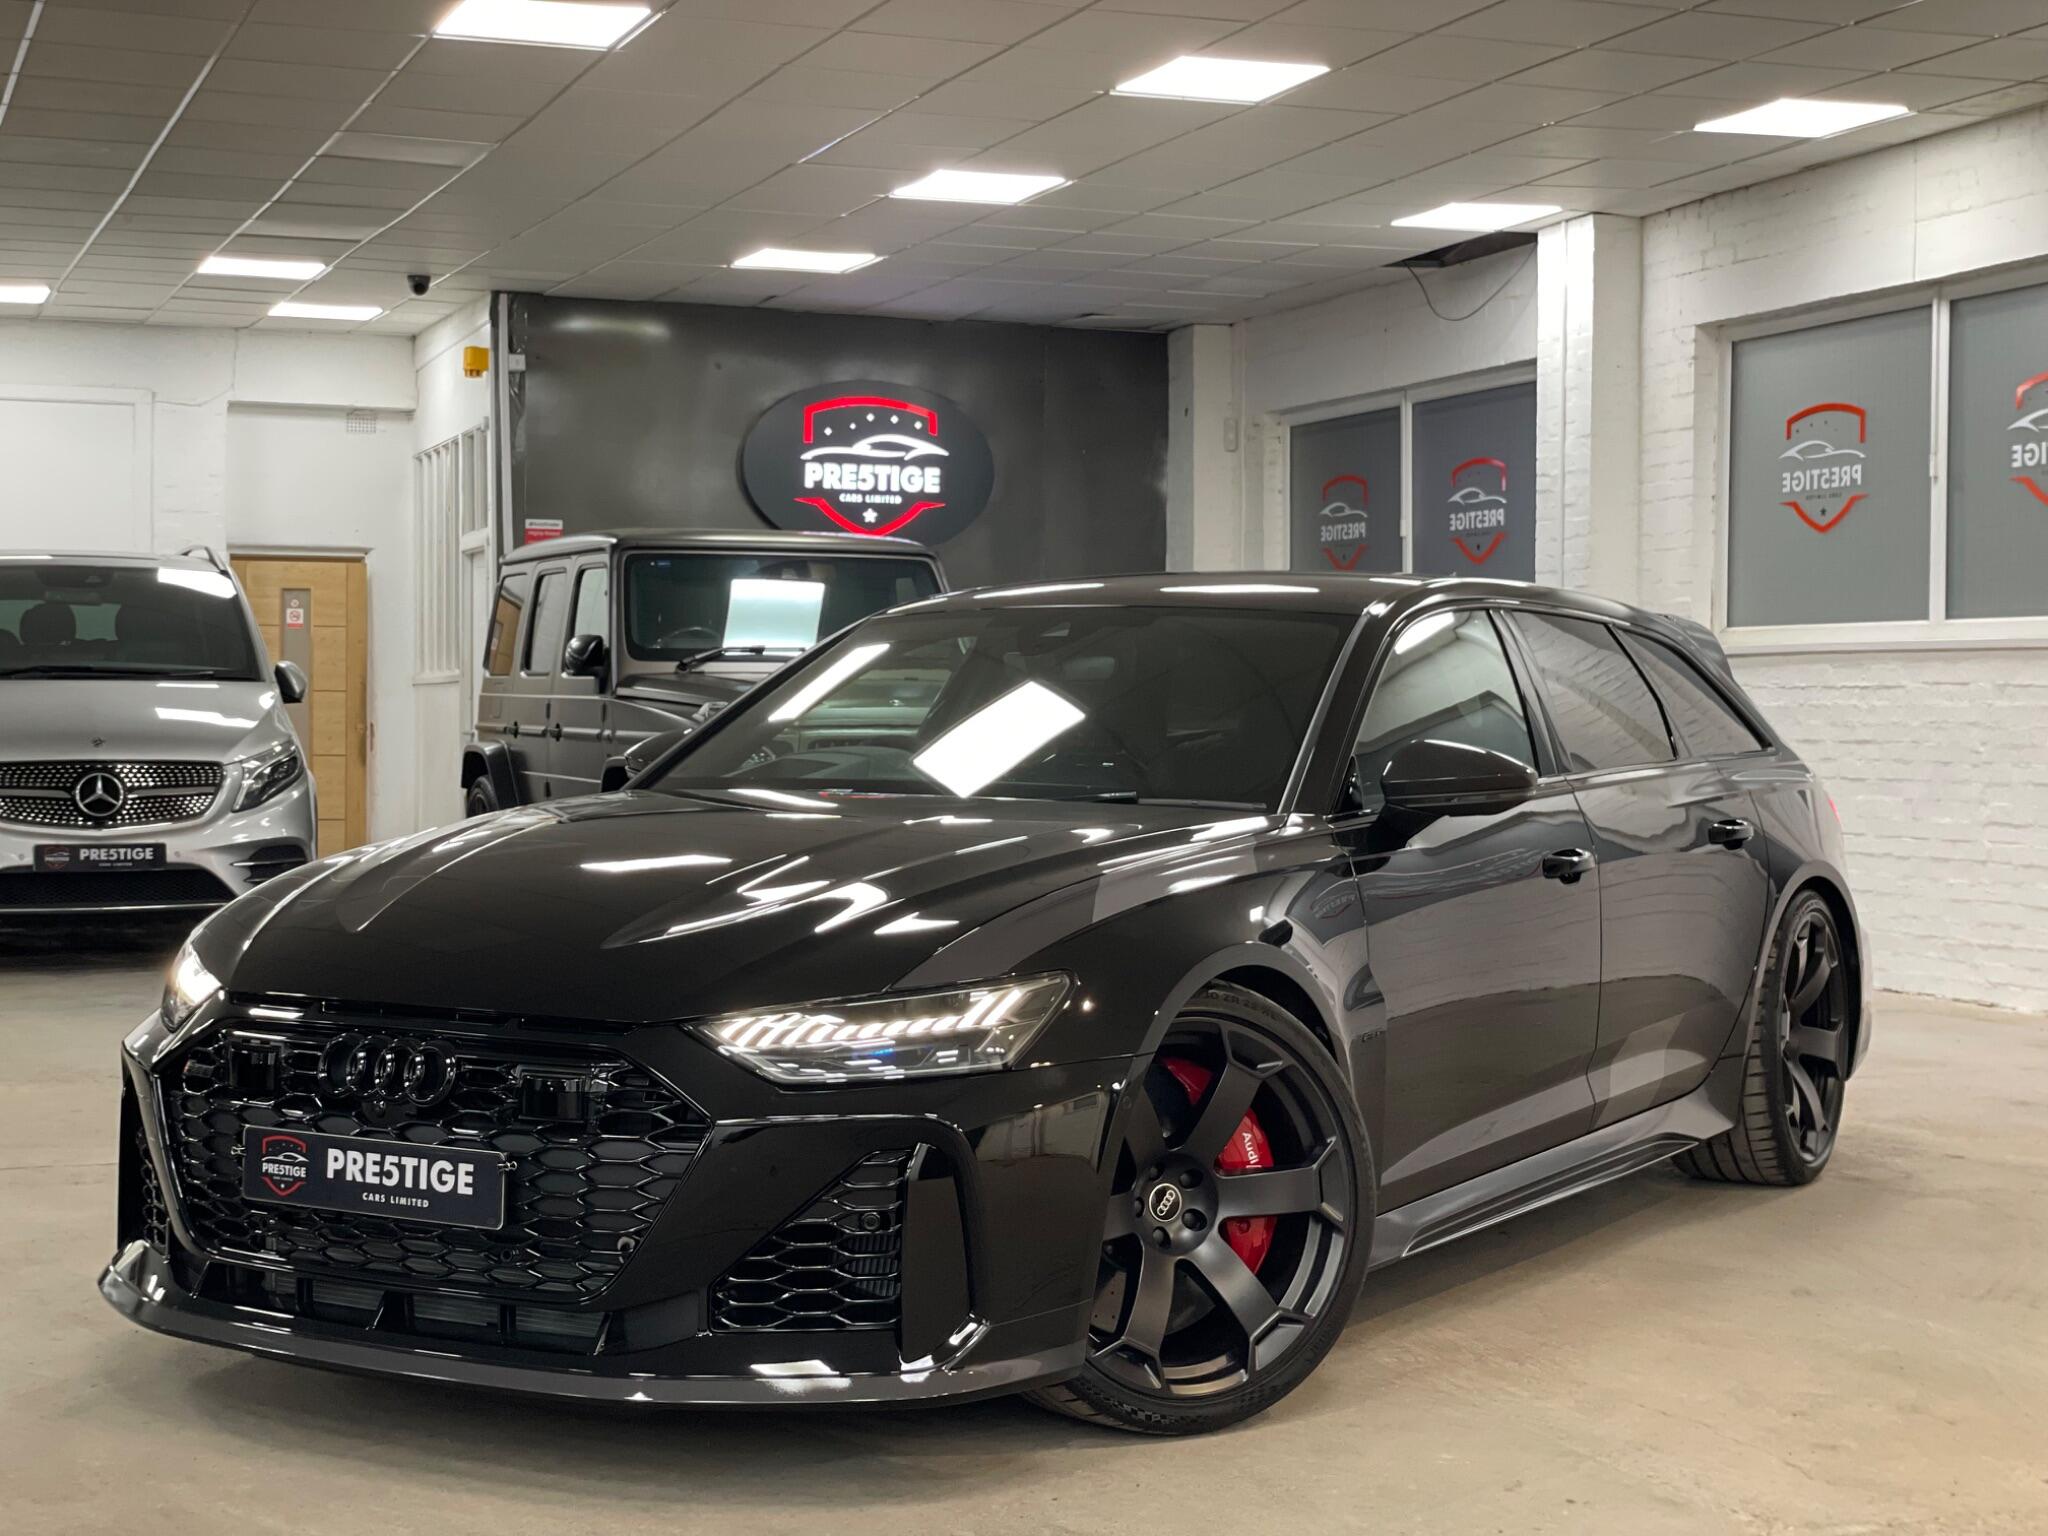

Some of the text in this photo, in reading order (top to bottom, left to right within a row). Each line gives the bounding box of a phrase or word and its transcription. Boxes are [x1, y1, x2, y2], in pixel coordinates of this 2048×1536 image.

[804, 462, 941, 493] PRE5TIGE
[1242, 1132, 1259, 1164] Audi
[326, 1148, 474, 1195] PRE5TIGE
[362, 1192, 429, 1208] CARS LIMITED
